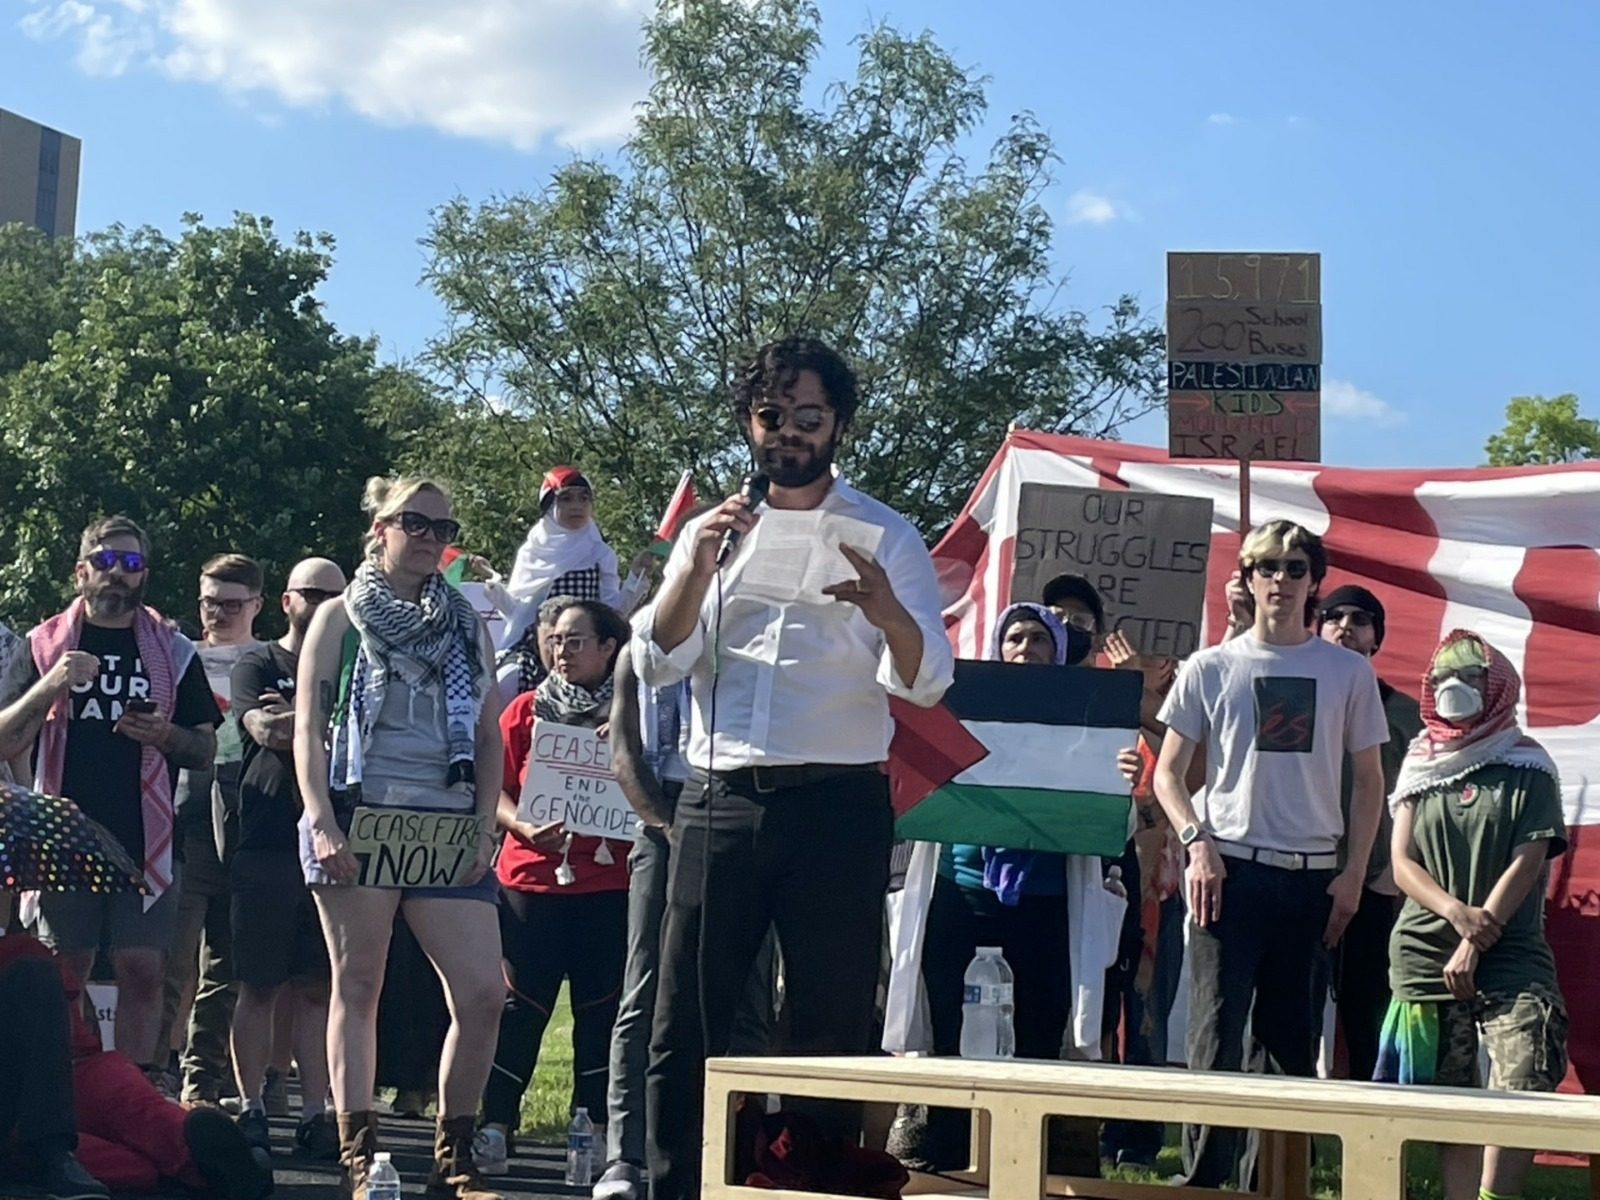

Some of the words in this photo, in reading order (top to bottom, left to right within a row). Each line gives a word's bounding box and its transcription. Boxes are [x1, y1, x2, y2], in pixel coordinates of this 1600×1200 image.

[1177, 307, 1244, 352] 200
[1246, 306, 1307, 326] School
[1171, 361, 1317, 389] PALESTINIAN
[1211, 392, 1284, 416] KIDS
[1083, 494, 1144, 525] OUR
[1017, 528, 1208, 573] STRUGGLES
[1083, 573, 1140, 605] RE
[535, 733, 612, 766] CEASE
[565, 776, 607, 794] END
[530, 794, 636, 835] GENOCIDE
[374, 843, 464, 886] NOW
